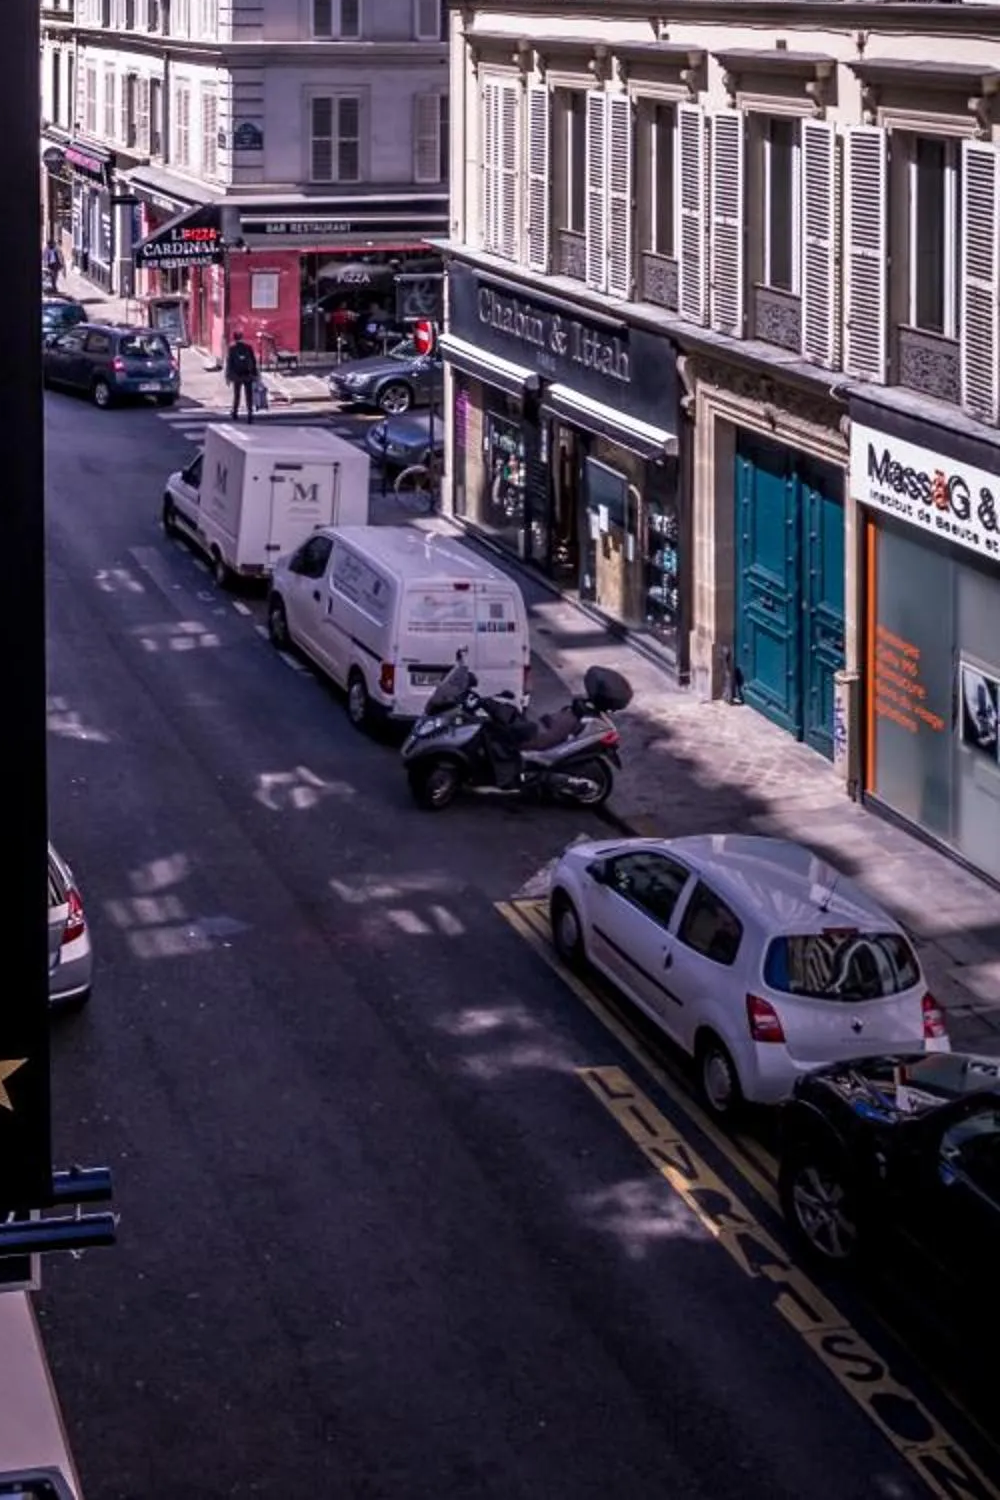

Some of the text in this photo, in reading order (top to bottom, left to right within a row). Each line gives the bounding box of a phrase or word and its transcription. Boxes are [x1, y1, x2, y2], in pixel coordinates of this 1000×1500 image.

[265, 222, 351, 233] BAR RESTAURANT
[143, 241, 219, 257] CARDINAL
[551, 314, 568, 356] &
[289, 483, 320, 503] M
